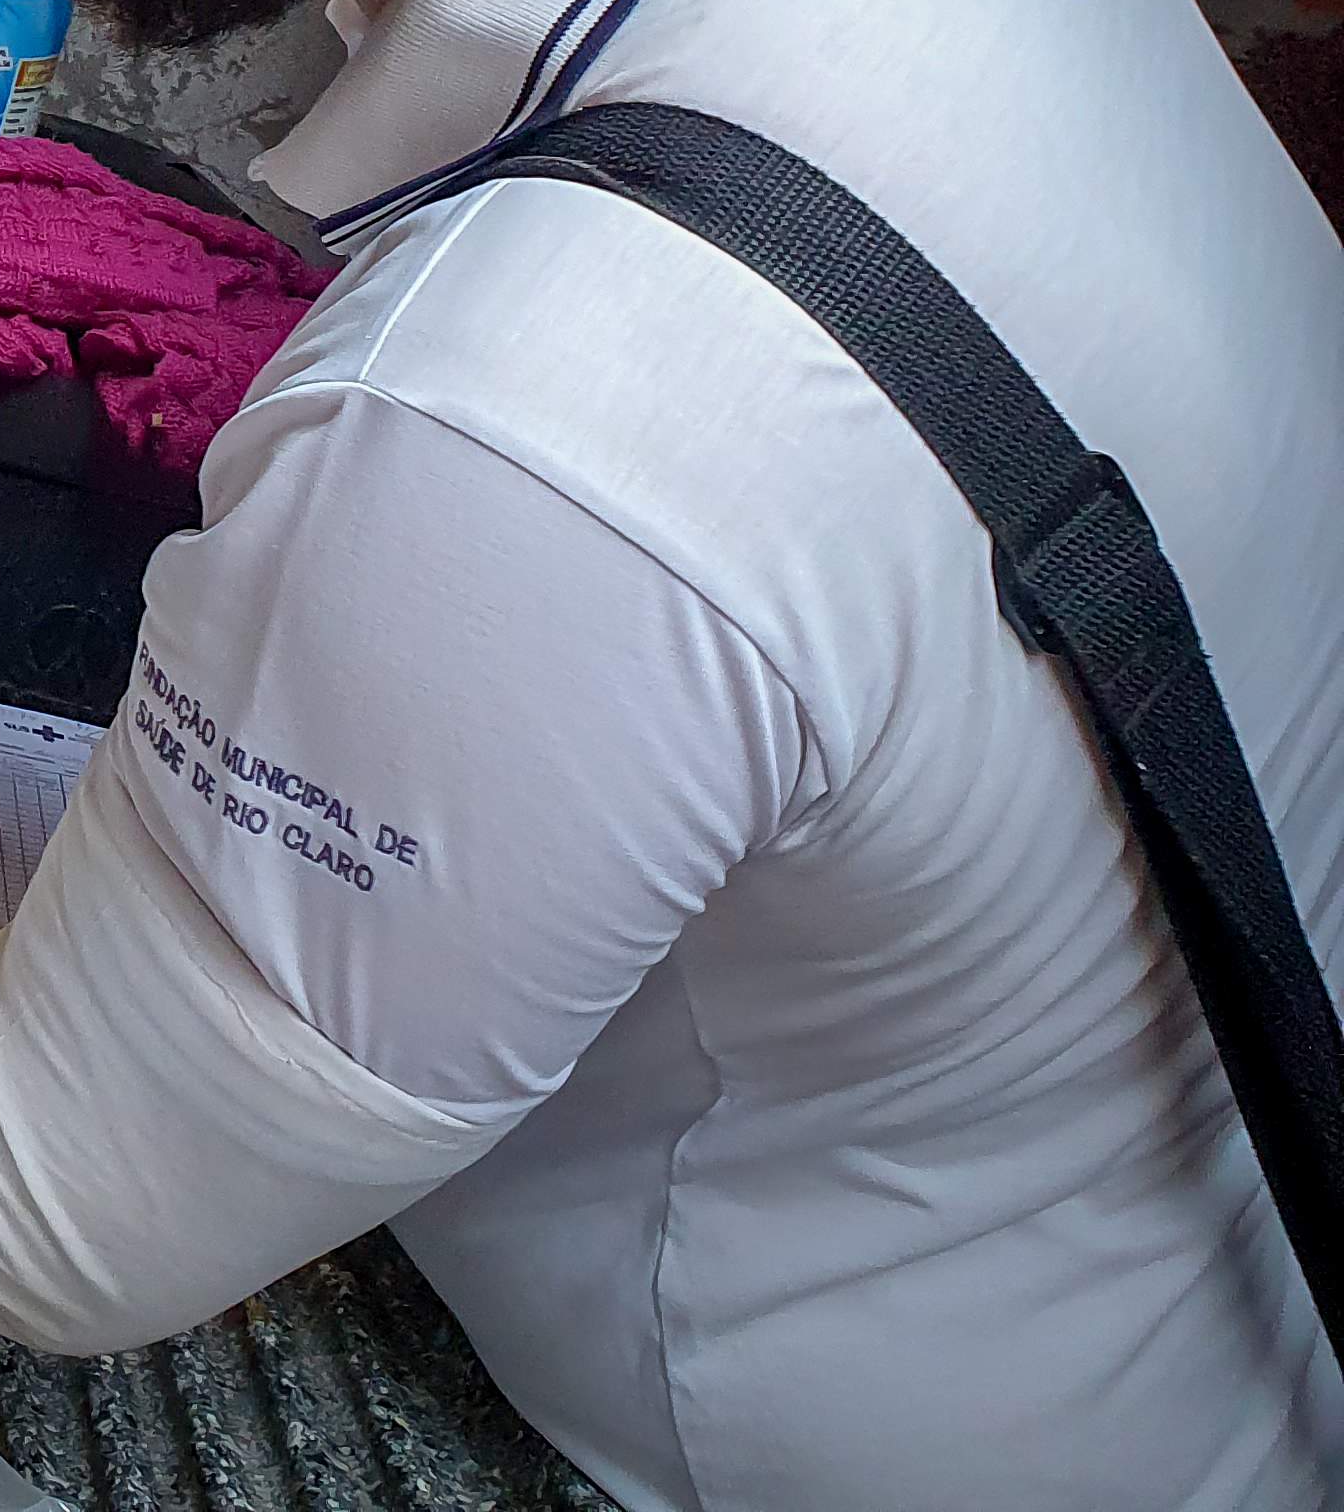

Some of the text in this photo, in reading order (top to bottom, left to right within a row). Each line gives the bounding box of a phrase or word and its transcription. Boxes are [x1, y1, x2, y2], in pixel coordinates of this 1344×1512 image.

[191, 761, 217, 805] DE
[222, 792, 270, 836] RIO
[282, 823, 376, 893] CLARO
[221, 736, 360, 839] MUNICIPAL
[374, 822, 419, 867] DE
